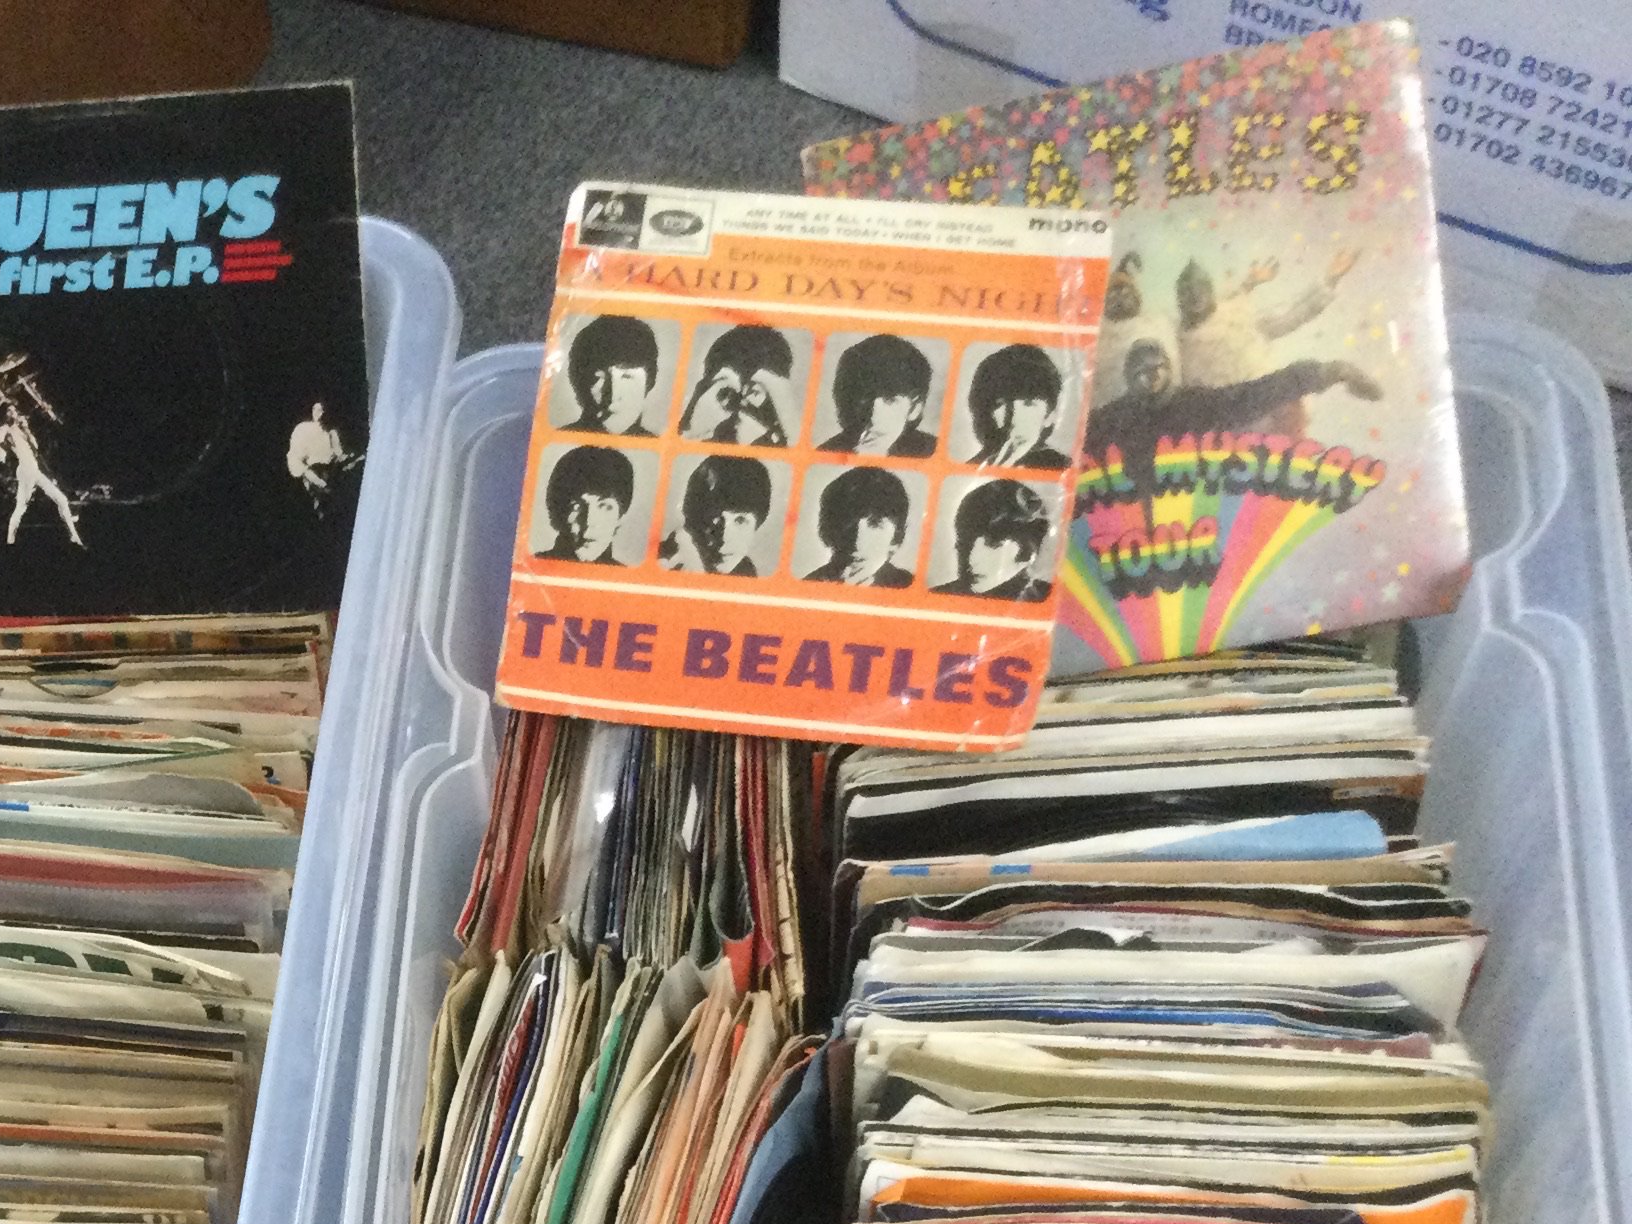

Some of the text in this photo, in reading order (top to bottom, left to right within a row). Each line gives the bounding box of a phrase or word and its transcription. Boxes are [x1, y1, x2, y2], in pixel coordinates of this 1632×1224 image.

[1028, 217, 1108, 235] mono
[123, 244, 220, 290] E.P.
[625, 261, 760, 291] HARD
[779, 272, 915, 305] DAY'S
[1152, 430, 1388, 508] MYSTERY
[1088, 515, 1222, 584] TOUR
[517, 609, 1034, 708] THE BEATLES
